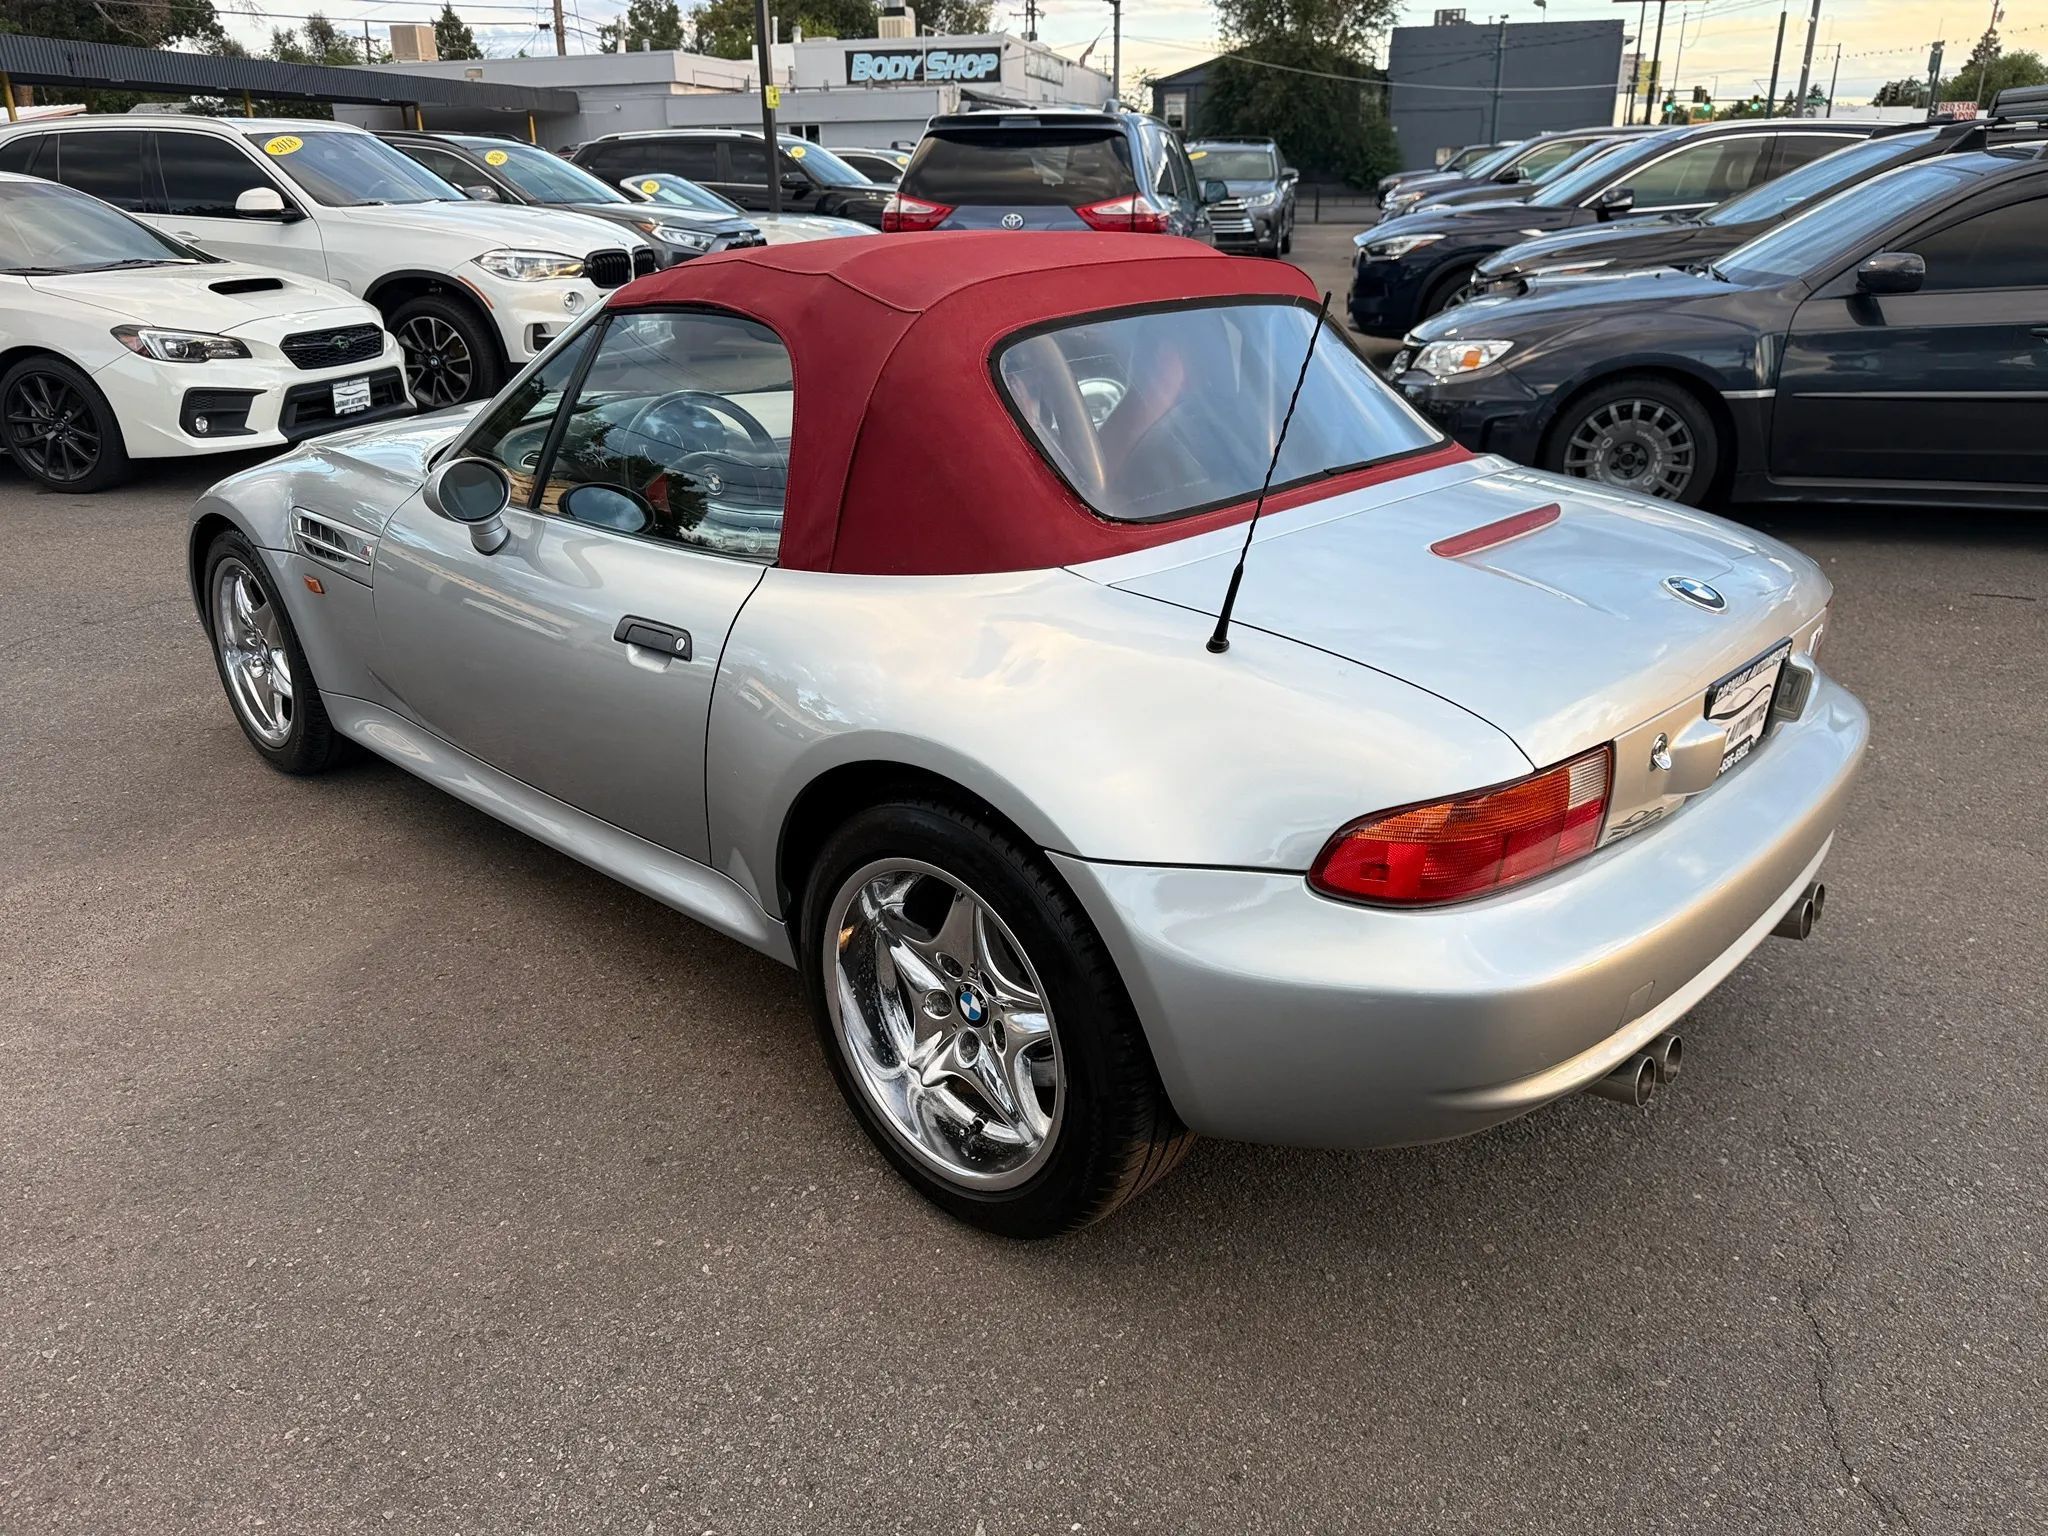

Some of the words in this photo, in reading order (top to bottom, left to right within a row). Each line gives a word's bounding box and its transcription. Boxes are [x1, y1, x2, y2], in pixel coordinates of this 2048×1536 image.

[851, 53, 923, 82] BODY
[926, 51, 998, 80] SHOP
[1939, 102, 1955, 113] RED
[1956, 101, 1977, 112] STAR
[271, 137, 298, 153] 2018
[960, 984, 988, 1009] BMW
